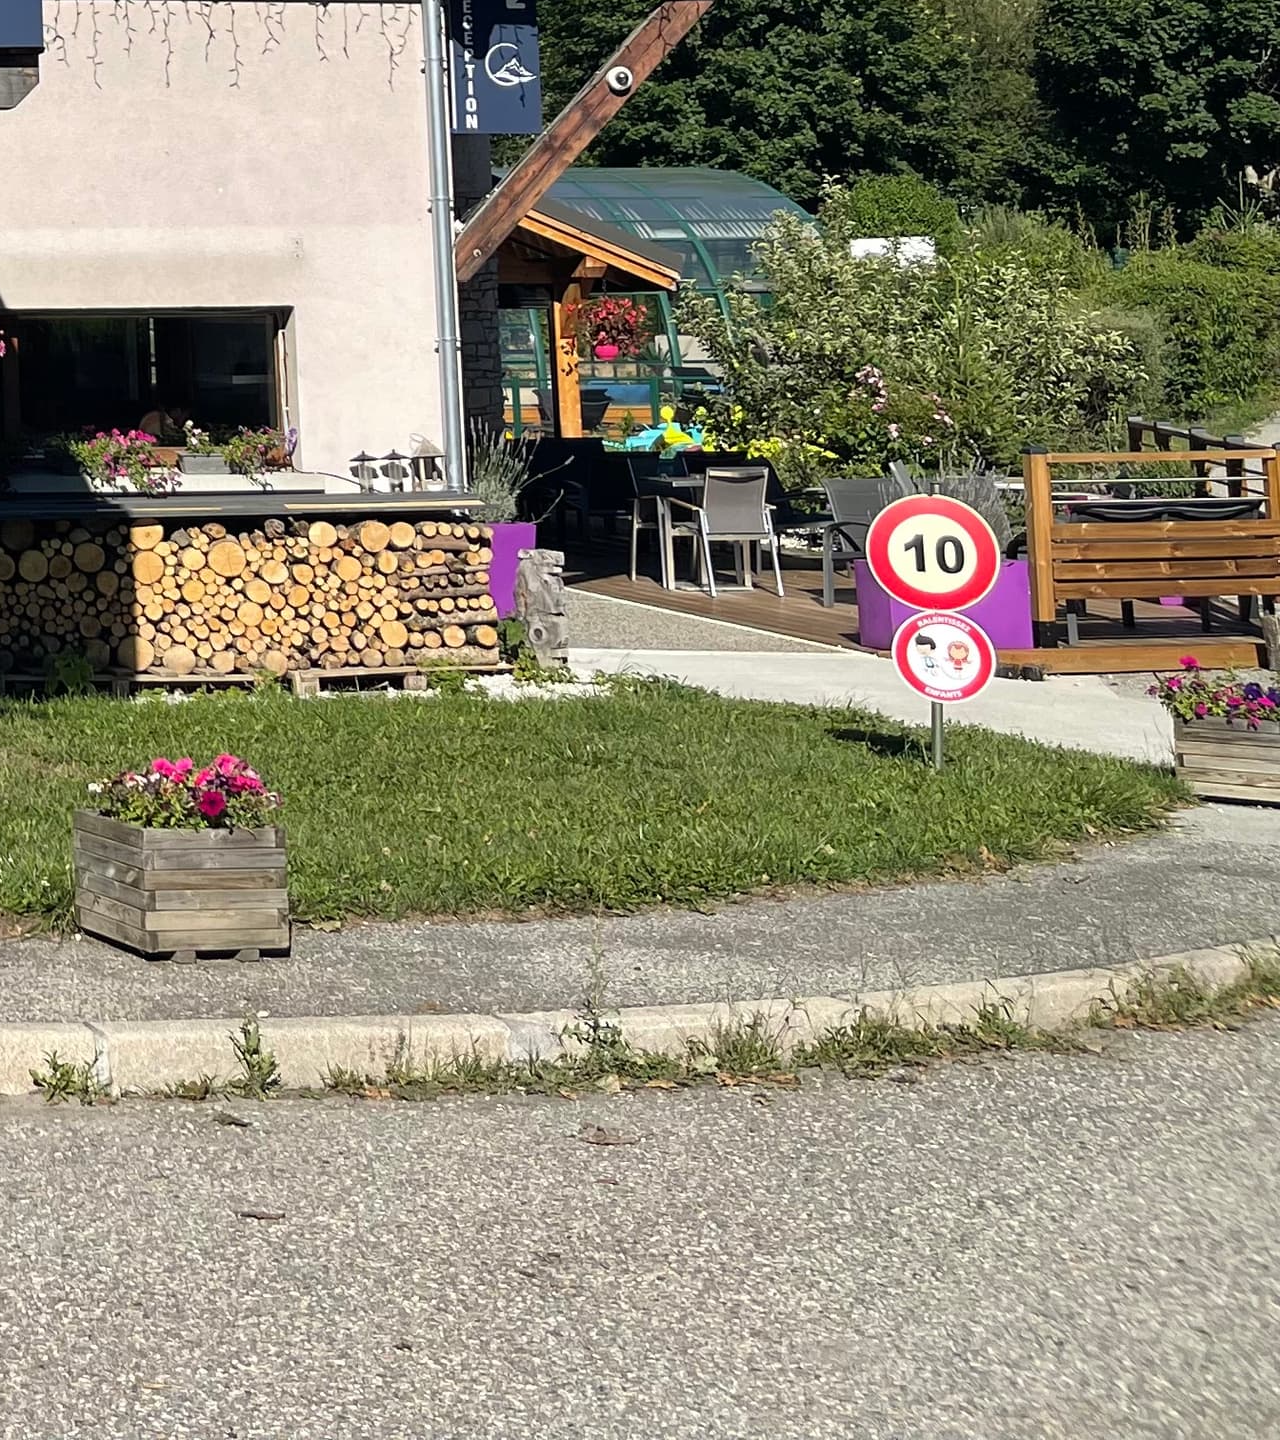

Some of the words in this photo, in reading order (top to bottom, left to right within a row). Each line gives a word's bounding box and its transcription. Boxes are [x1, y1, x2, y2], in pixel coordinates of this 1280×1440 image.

[903, 533, 965, 575] 10
[916, 615, 972, 633] RALENTISSEZ
[924, 685, 963, 699] ENFANTS
